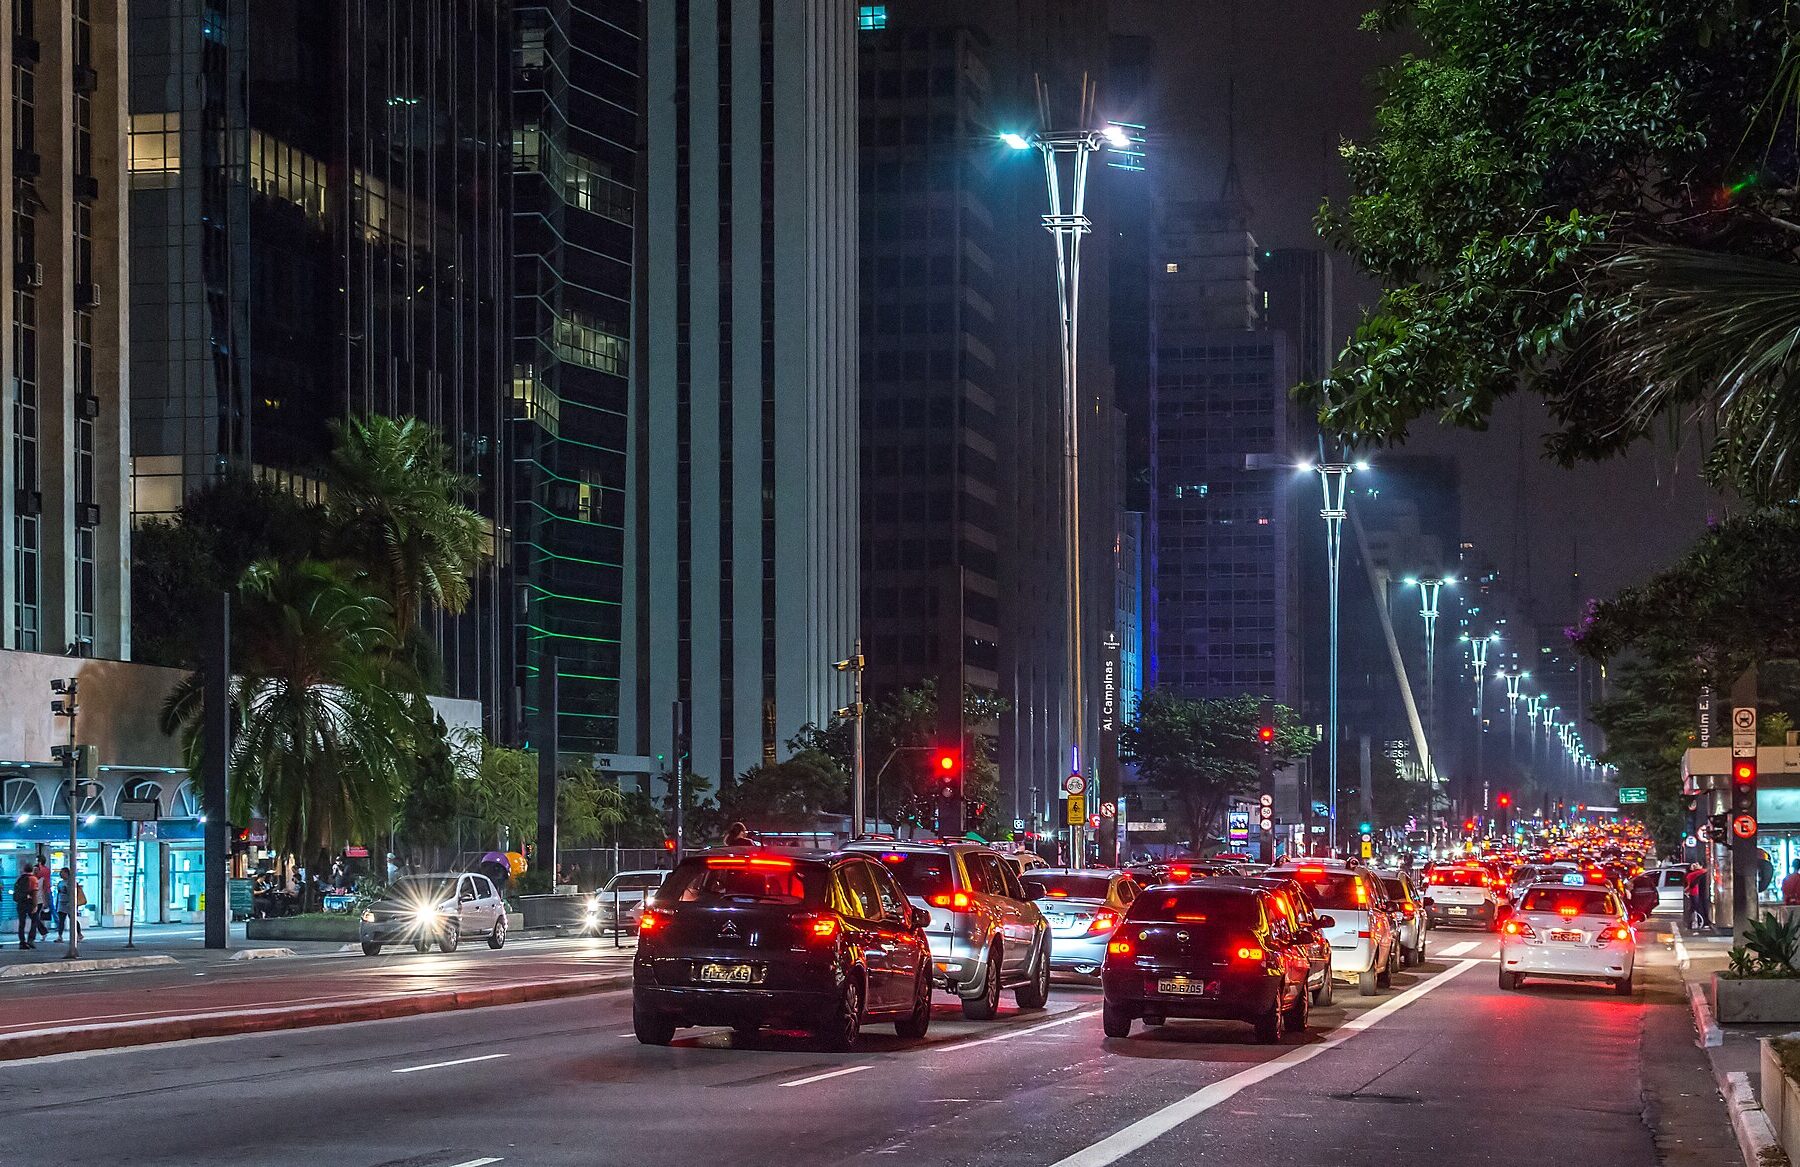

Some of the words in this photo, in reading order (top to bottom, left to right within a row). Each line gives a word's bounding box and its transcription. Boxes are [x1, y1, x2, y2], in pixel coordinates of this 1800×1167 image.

[1103, 660, 1115, 715] Campinas
[1699, 700, 1709, 710] E.
[1103, 717, 1113, 731] Al.
[1699, 713, 1710, 748] aquim
